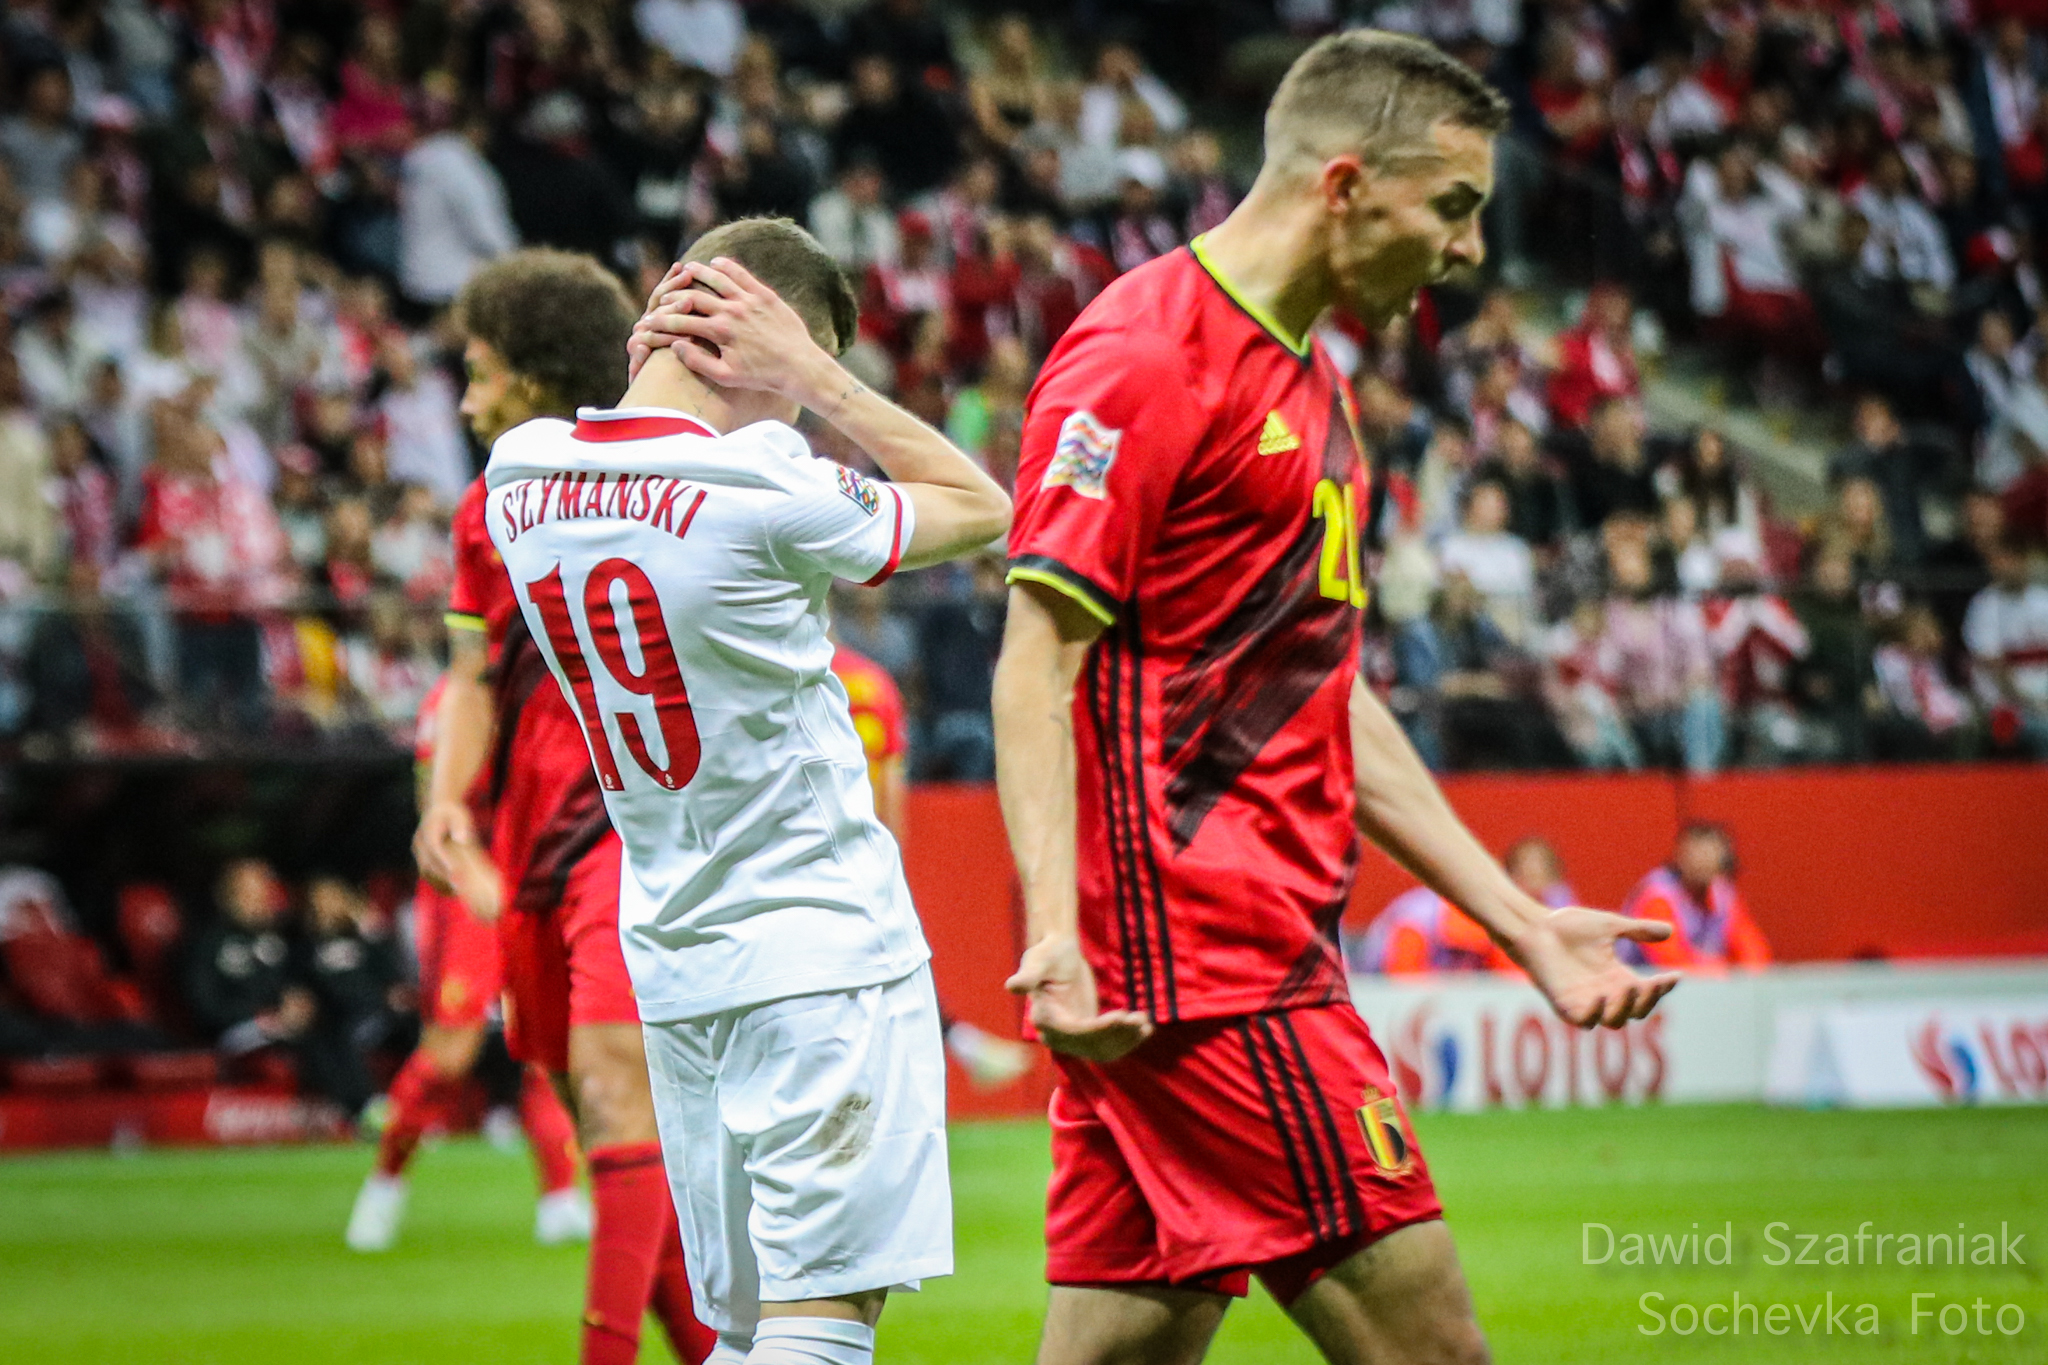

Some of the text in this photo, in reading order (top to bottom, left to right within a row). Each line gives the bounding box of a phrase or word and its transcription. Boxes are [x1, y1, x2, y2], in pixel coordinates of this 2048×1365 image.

[526, 557, 701, 791] 19
[1479, 1013, 1666, 1104] LOTOS
[1979, 1018, 2048, 1100] LO
